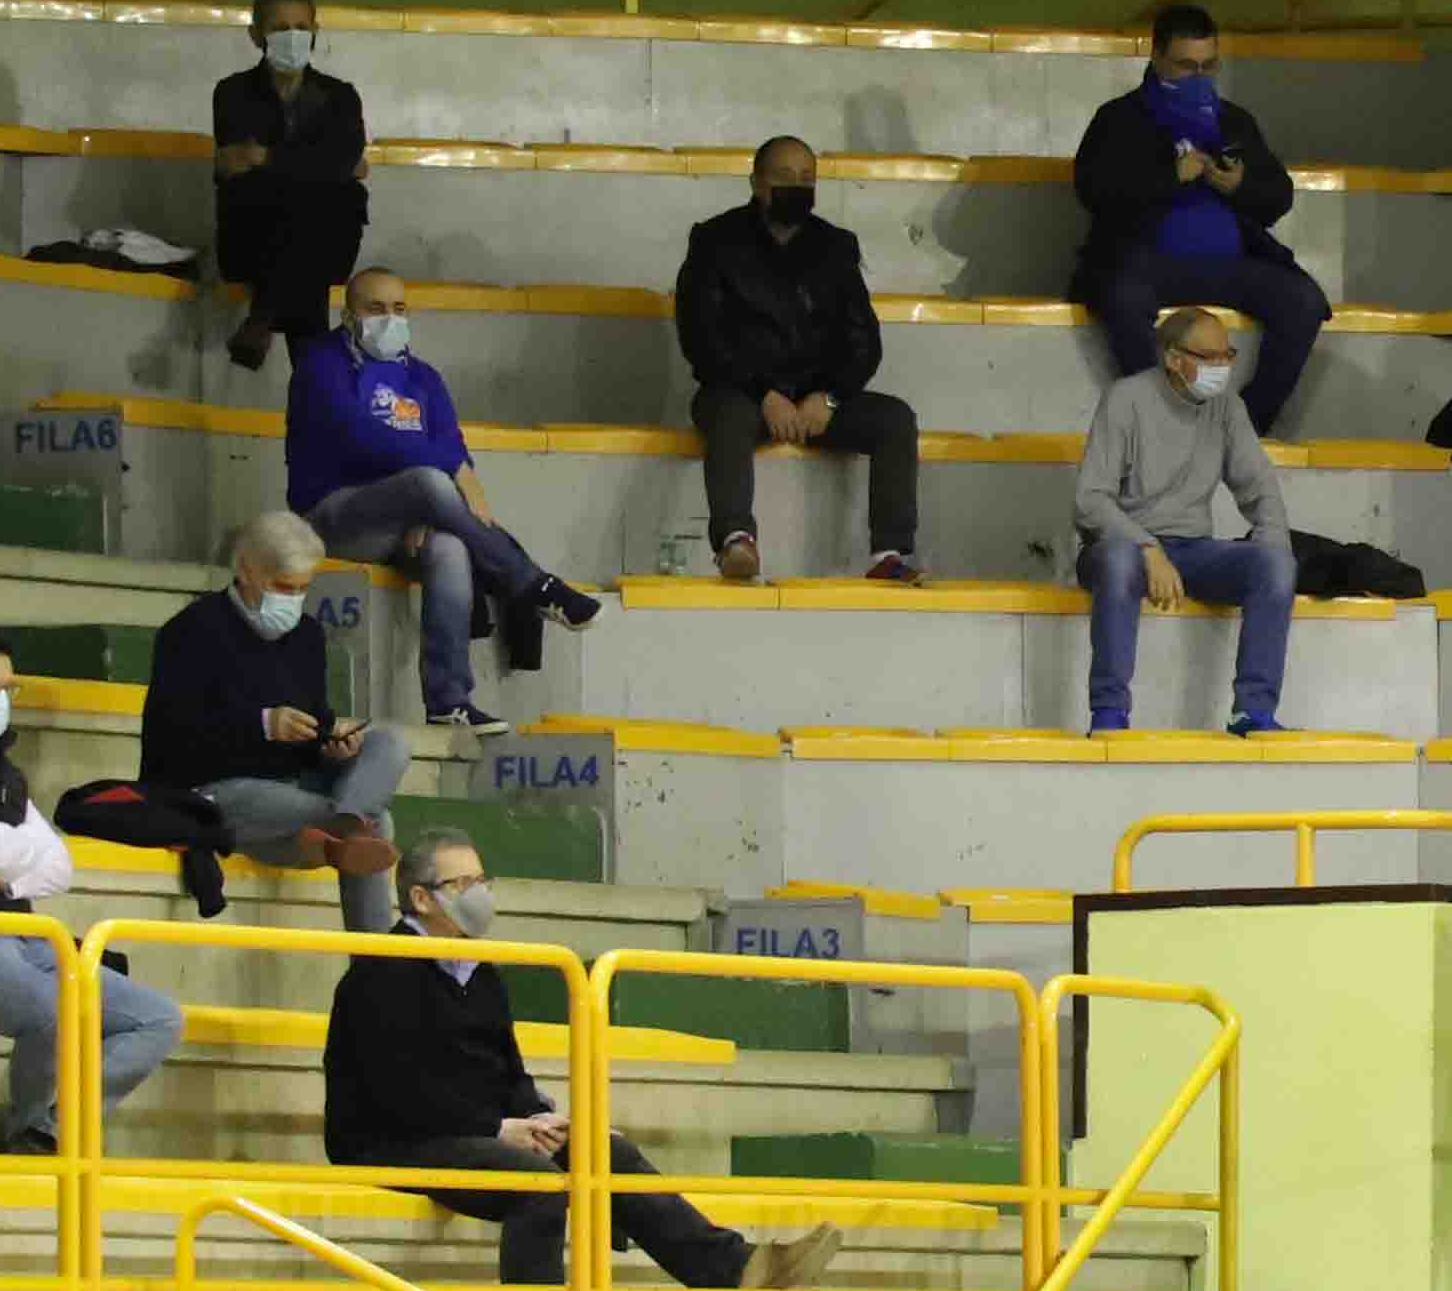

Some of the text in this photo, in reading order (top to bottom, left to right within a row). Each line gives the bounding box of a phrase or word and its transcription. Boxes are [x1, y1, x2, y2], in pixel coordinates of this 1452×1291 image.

[15, 416, 118, 454] FILA6
[494, 756, 599, 789] FILA4
[736, 927, 840, 959] FILA3
